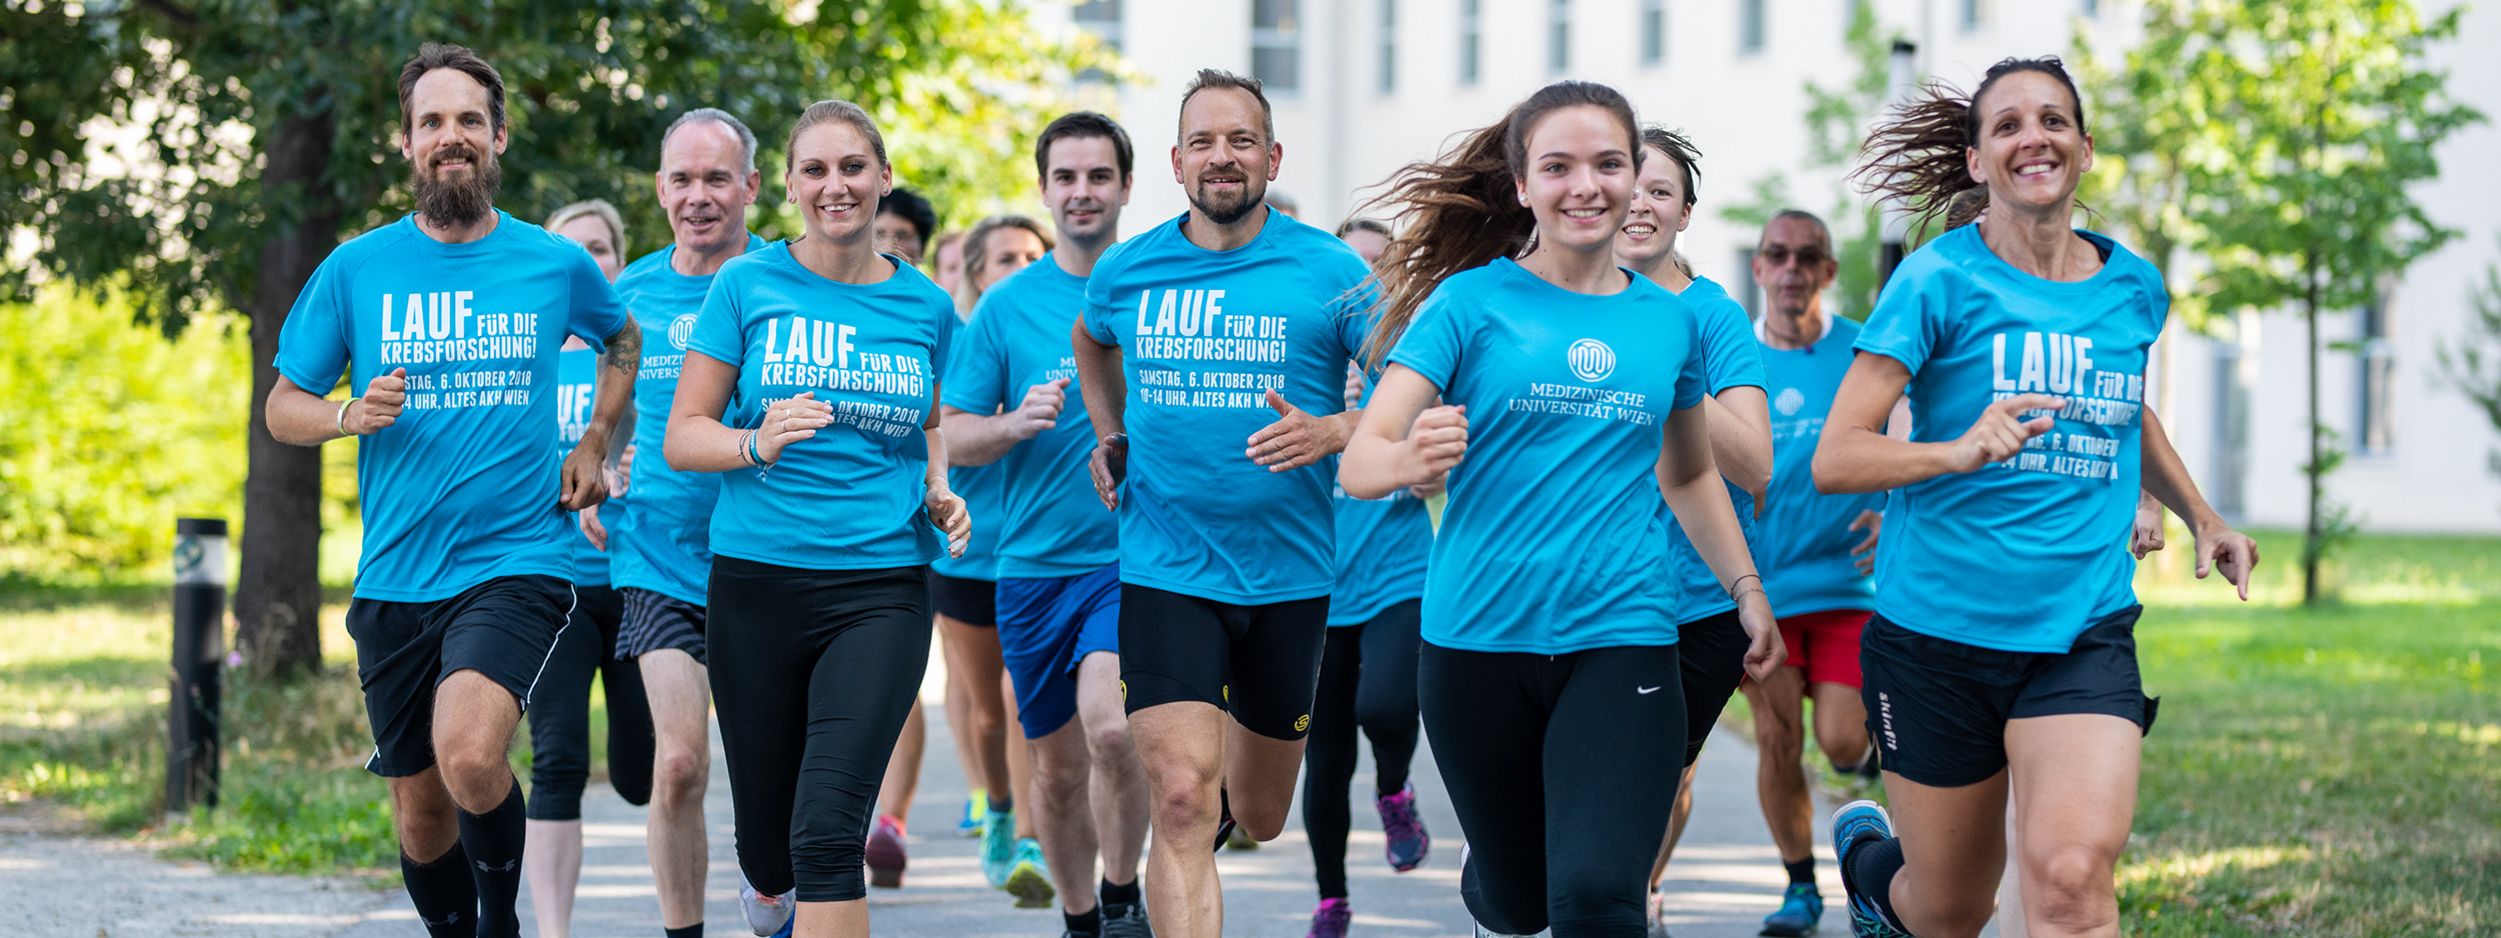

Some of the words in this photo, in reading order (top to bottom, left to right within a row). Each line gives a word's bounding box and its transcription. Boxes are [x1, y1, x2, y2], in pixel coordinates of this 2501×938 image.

[382, 291, 473, 341] LAUF
[477, 313, 509, 336] FÜR
[514, 313, 538, 335] DIE
[1136, 289, 1225, 337] LAUF
[1224, 315, 1255, 338] FÜR
[1259, 315, 1287, 339] DIE
[381, 337, 537, 365] KREBSFORSCHUNG!
[763, 316, 857, 369] LAUF
[859, 352, 893, 373] FÜR
[896, 354, 922, 376] DIE
[1136, 337, 1286, 363] KREBSFORSCHUNG!
[1993, 331, 2093, 395] LAUF
[2094, 370, 2124, 399] FÜR
[440, 374, 452, 389] 6.
[455, 371, 506, 388] OKTOBER
[509, 370, 531, 386] 2018
[761, 363, 924, 398] KREBSFORSCHUNG!
[1139, 370, 1184, 388] SAMSTAG,
[1189, 371, 1200, 387] 6.
[1203, 372, 1254, 388] OKTOBER
[1257, 374, 1285, 389] 2018
[415, 393, 441, 410] UHR,
[444, 392, 477, 408] ALTES
[479, 390, 501, 406] AKH
[504, 390, 530, 406] WIEN
[1165, 389, 1190, 407] UHR,
[1192, 391, 1226, 407] ALTES
[1228, 392, 1251, 408] AKH
[1530, 382, 1646, 408] MEDIZINISCHE
[838, 400, 891, 420] OKTOBER
[893, 407, 920, 424] 2018
[857, 417, 885, 433] AKH
[1509, 399, 1614, 420] UNIVERSITÄT
[1616, 407, 1656, 426] WIEN
[2052, 455, 2090, 478] ALTES
